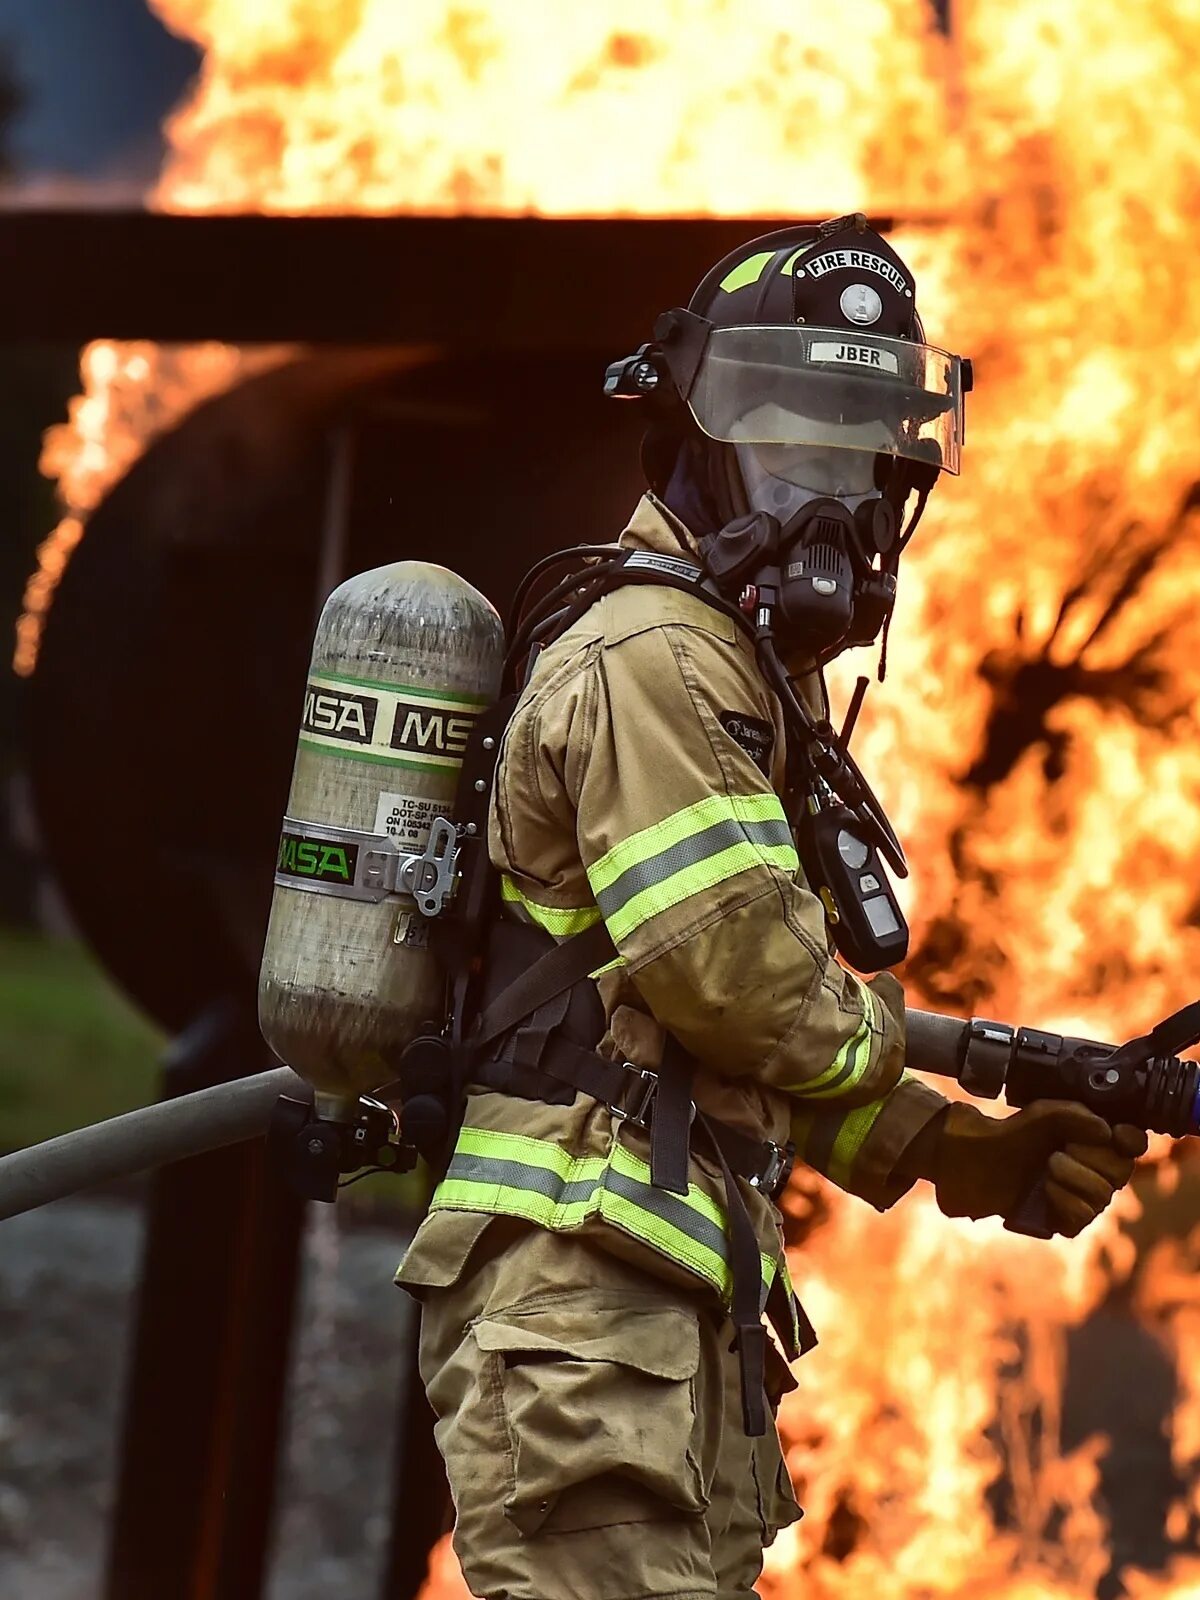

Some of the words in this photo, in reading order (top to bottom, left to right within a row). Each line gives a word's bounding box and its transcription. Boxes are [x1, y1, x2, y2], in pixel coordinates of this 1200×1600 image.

[809, 252, 847, 275] FIRE
[850, 252, 905, 290] RESCUE
[836, 345, 881, 365] JBER
[399, 711, 474, 751] MS
[402, 799, 432, 811] TC-SU
[386, 816, 401, 826] ON
[392, 807, 428, 820] DOT-SP
